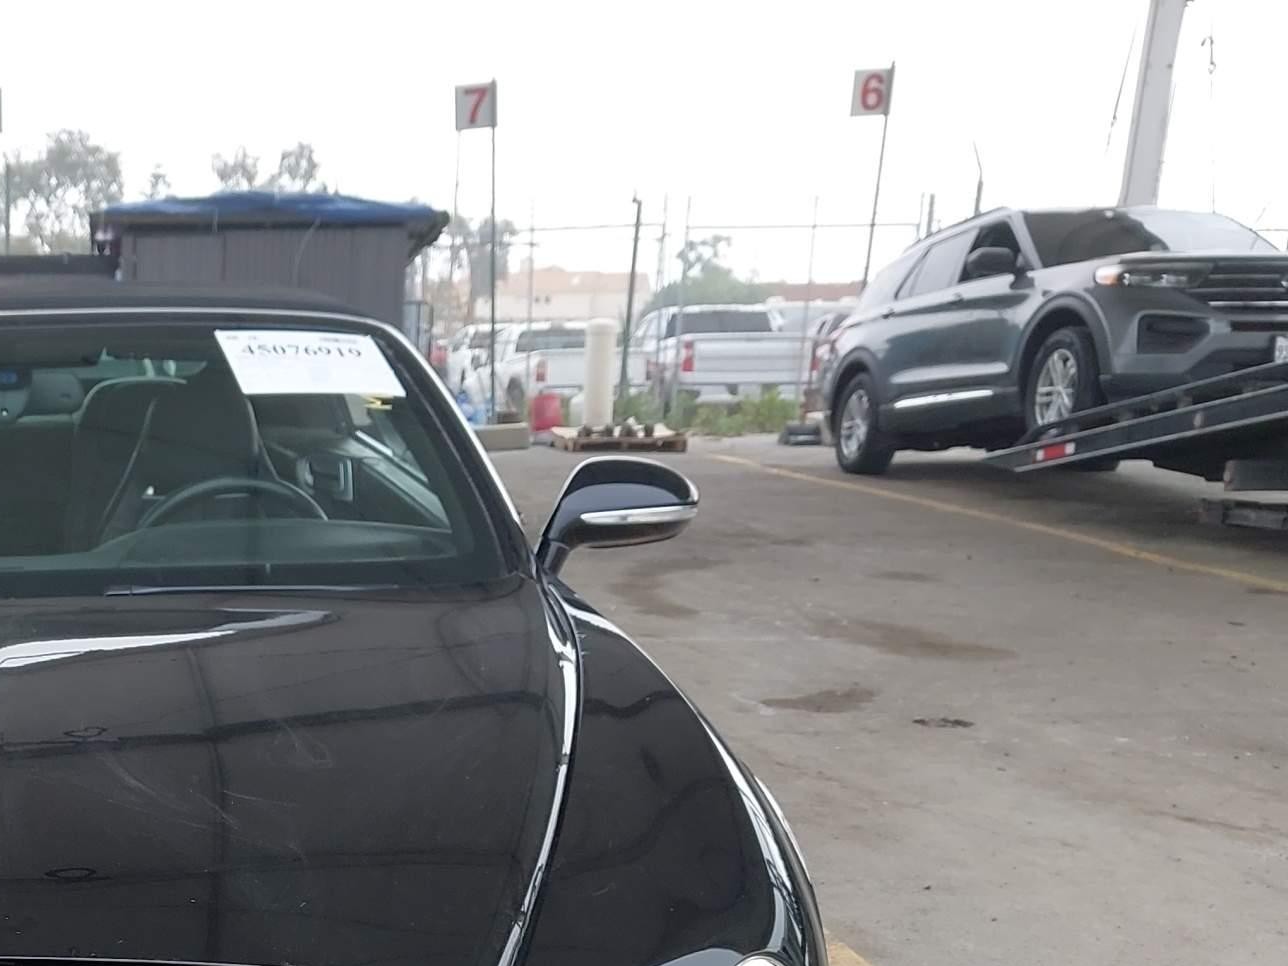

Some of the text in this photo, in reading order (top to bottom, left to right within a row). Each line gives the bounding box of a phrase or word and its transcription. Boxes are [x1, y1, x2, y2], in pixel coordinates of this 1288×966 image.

[464, 86, 488, 124] 7
[861, 73, 884, 111] 6
[242, 344, 362, 357] 45076919
